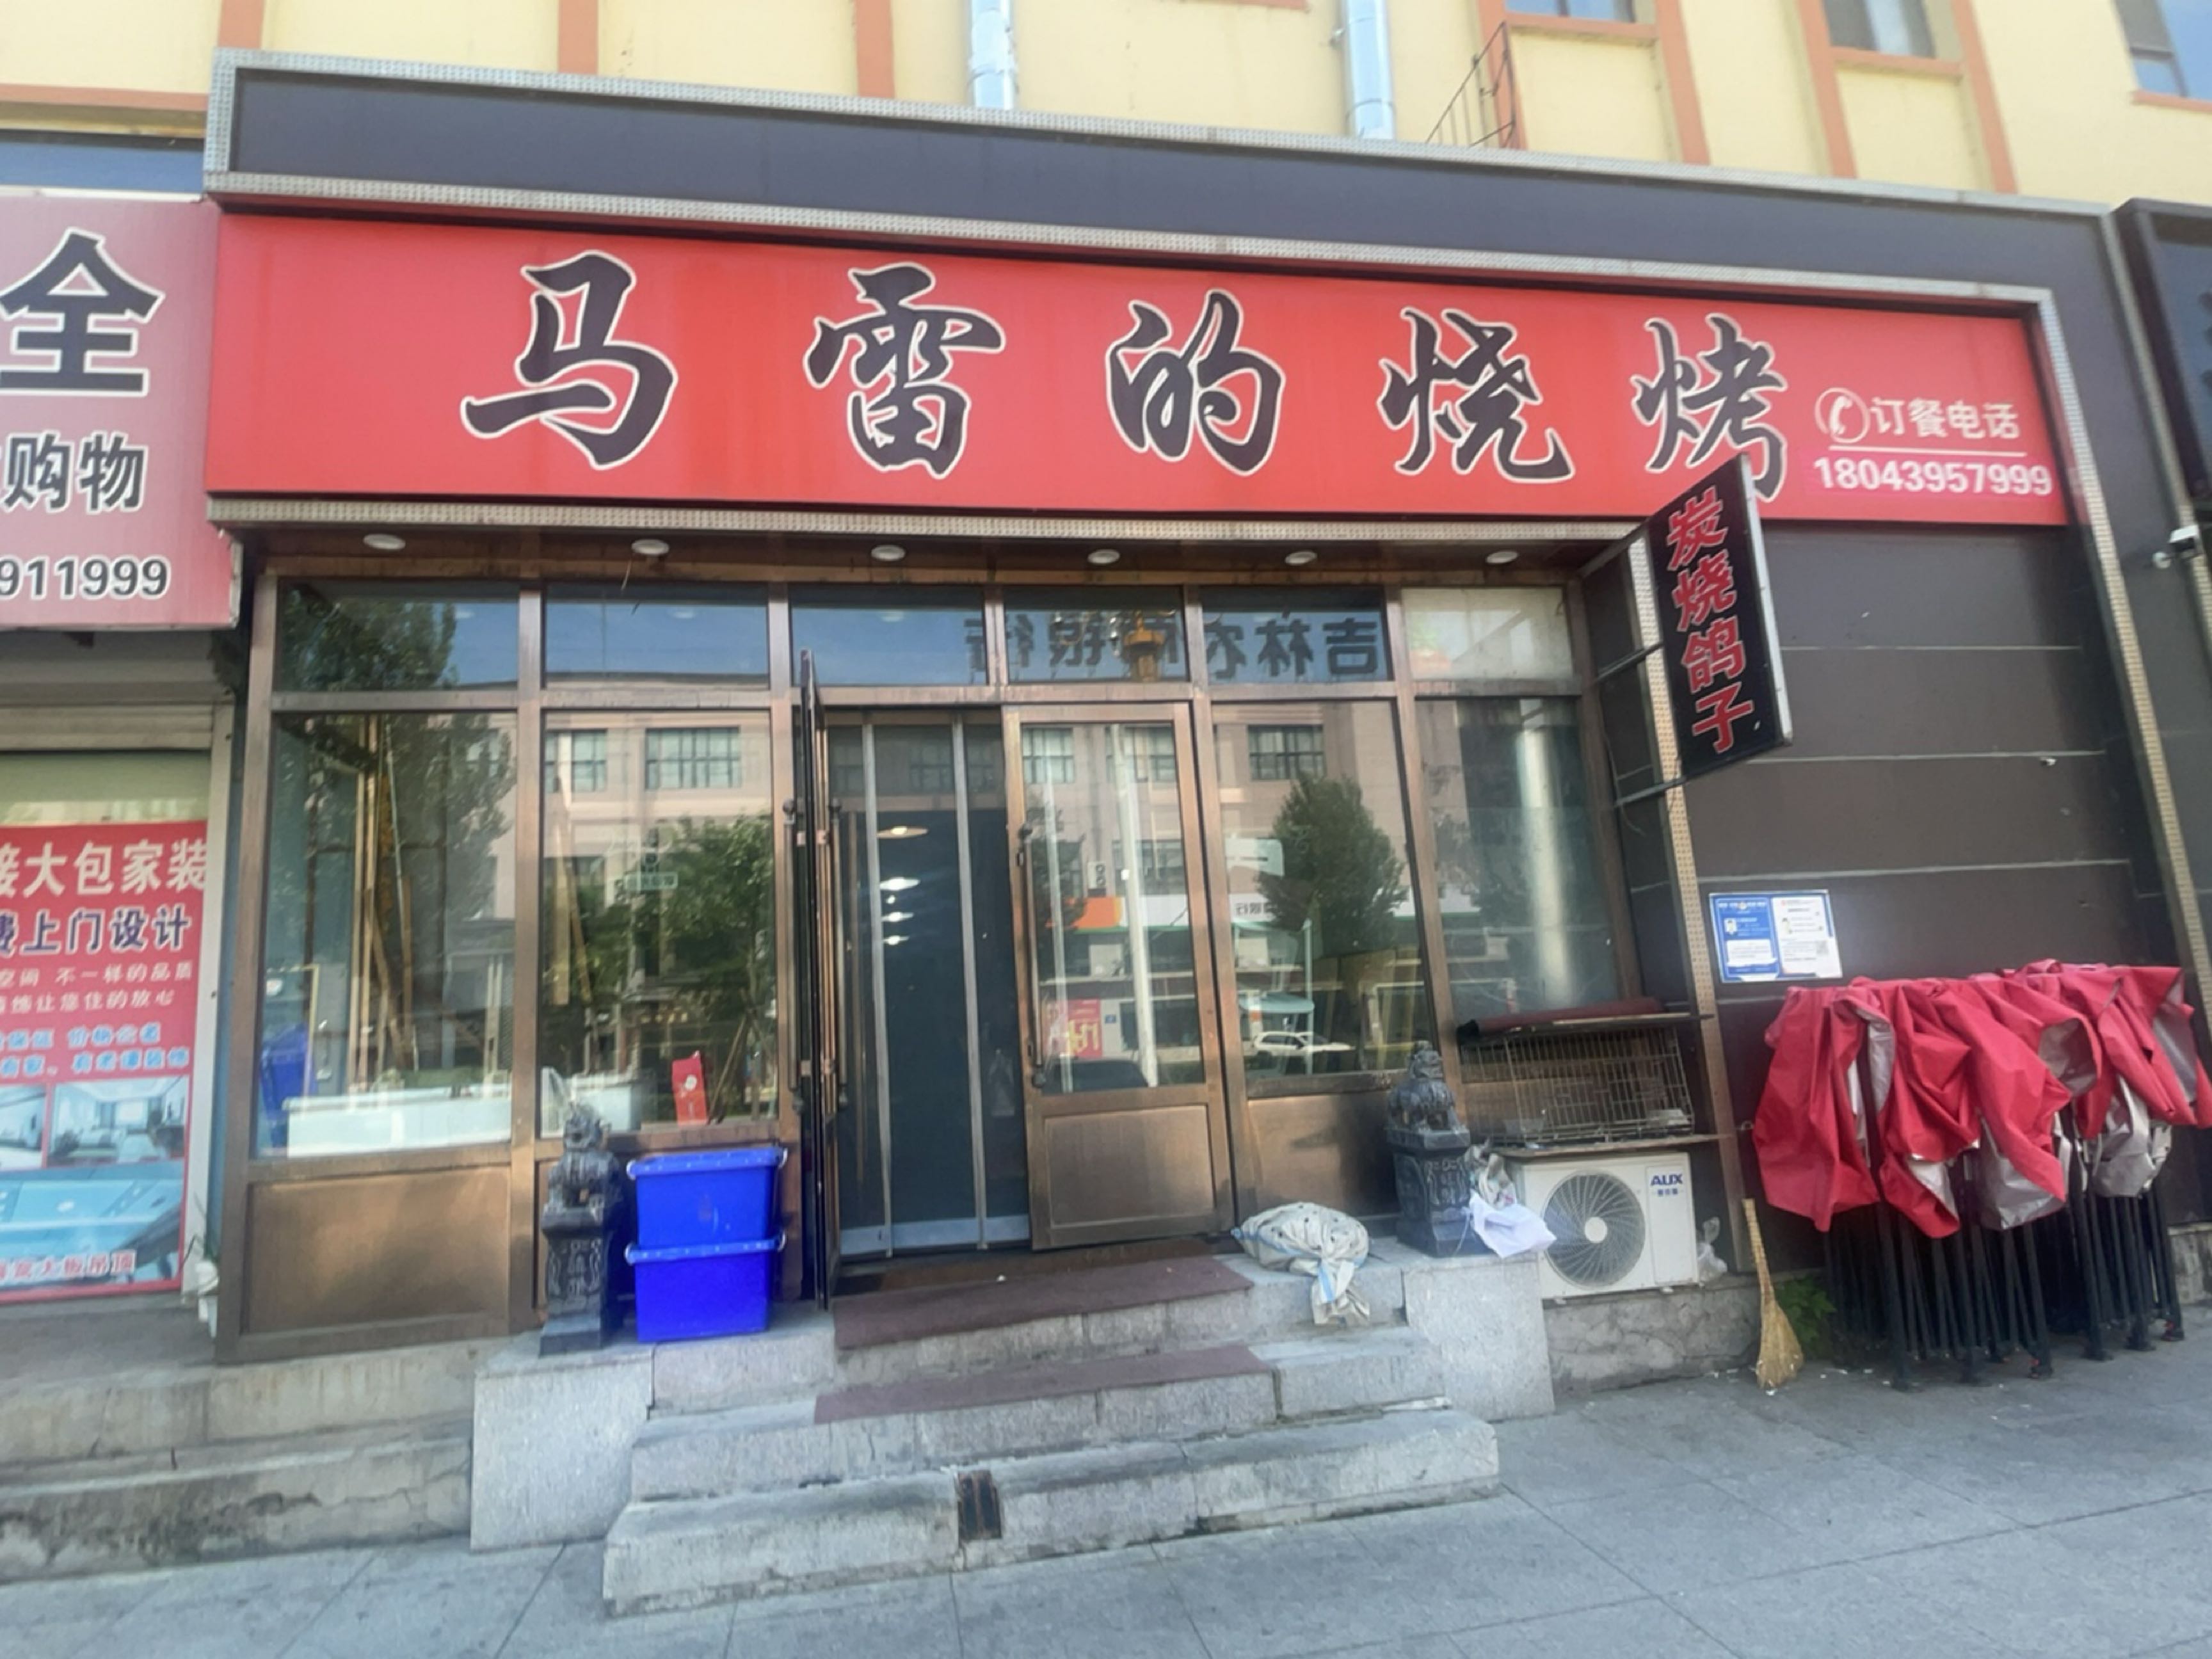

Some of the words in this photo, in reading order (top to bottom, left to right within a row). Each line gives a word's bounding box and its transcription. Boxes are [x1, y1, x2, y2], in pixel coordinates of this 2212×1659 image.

[0, 227, 165, 397] 全
[460, 250, 1788, 503] 马雷的烧烤
[1871, 397, 2021, 440] 订餐电话
[3, 429, 148, 516] 购物
[1813, 456, 2053, 496] 18043957999
[0, 554, 172, 600] 911999
[1667, 485, 1754, 755] 炭烧鸽子
[1651, 1173, 1683, 1187] AUX
